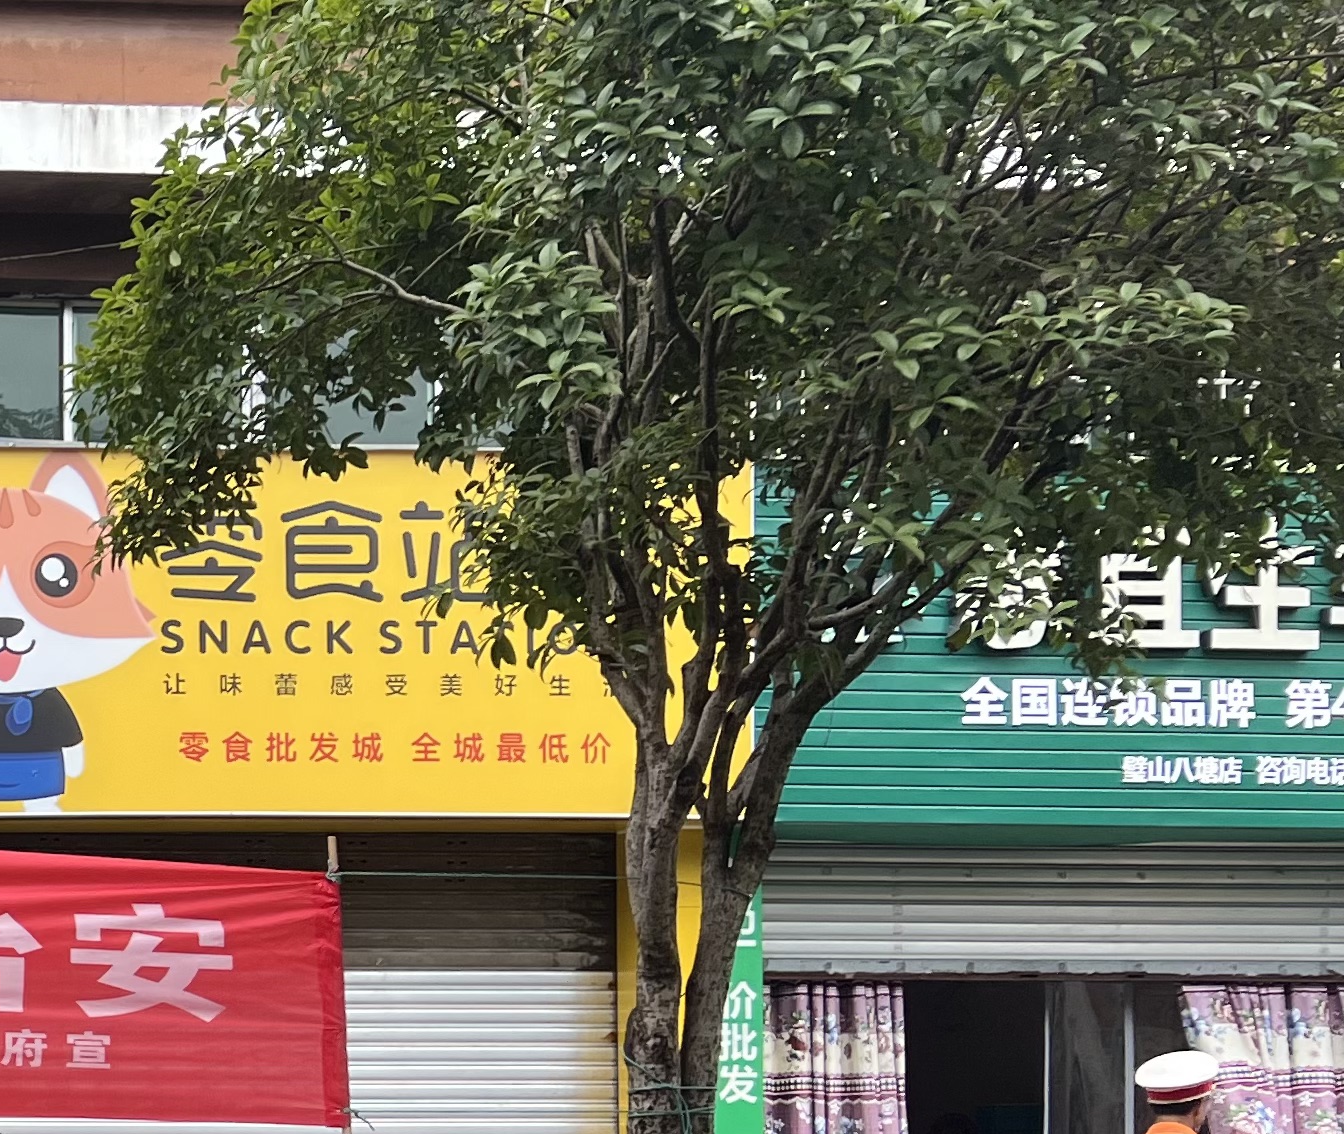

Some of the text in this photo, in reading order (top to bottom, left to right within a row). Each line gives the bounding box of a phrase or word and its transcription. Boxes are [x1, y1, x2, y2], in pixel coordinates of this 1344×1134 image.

[161, 619, 353, 654] SNACK
[163, 672, 612, 698] 让味蕾感受美好生
[960, 676, 1256, 729] 全国连锁品牌
[178, 731, 613, 766] 零食批发城 全城最低价
[1121, 755, 1243, 785] 璧山八塘店
[64, 1029, 113, 1070] 宣
